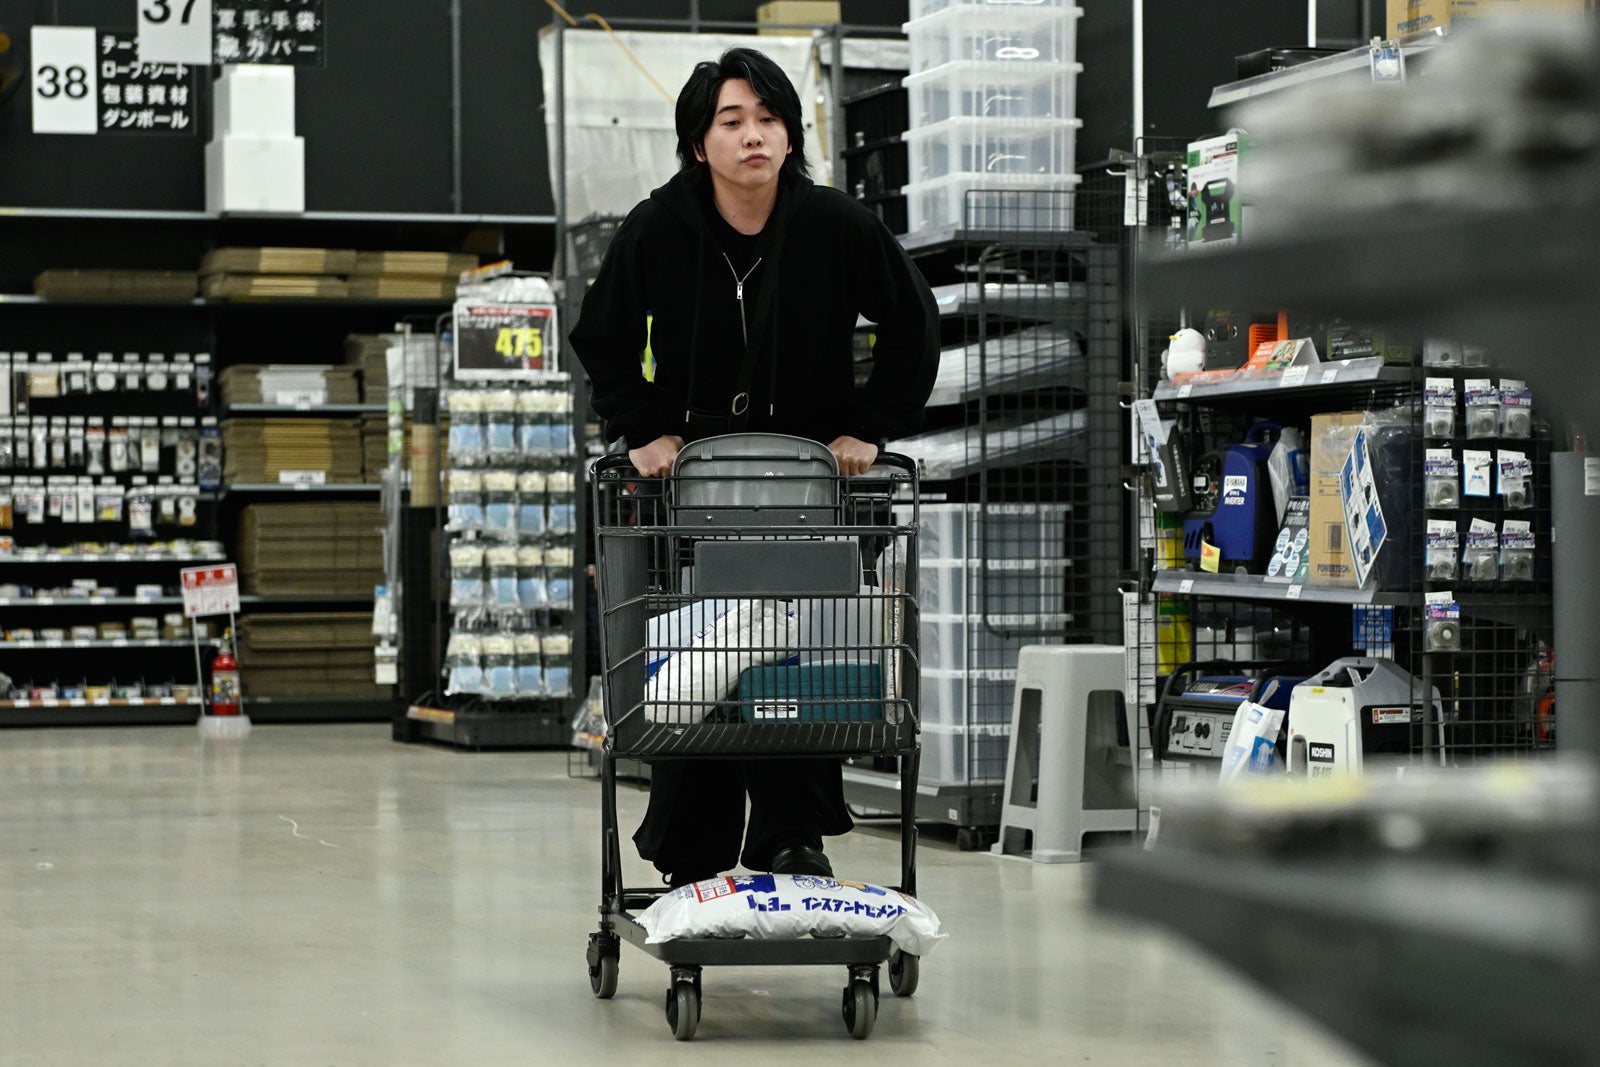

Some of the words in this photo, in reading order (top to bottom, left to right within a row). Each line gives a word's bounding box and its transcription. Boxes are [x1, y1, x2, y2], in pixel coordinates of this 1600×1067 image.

[142, 0, 196, 25] 37
[102, 35, 139, 55] テー
[36, 65, 89, 99] 38
[102, 108, 190, 129] ダンボール
[494, 326, 543, 358] 475
[1316, 563, 1351, 574] POWERTECH
[1311, 747, 1333, 759] KOSHIN
[801, 896, 908, 919] インスタントセメント
